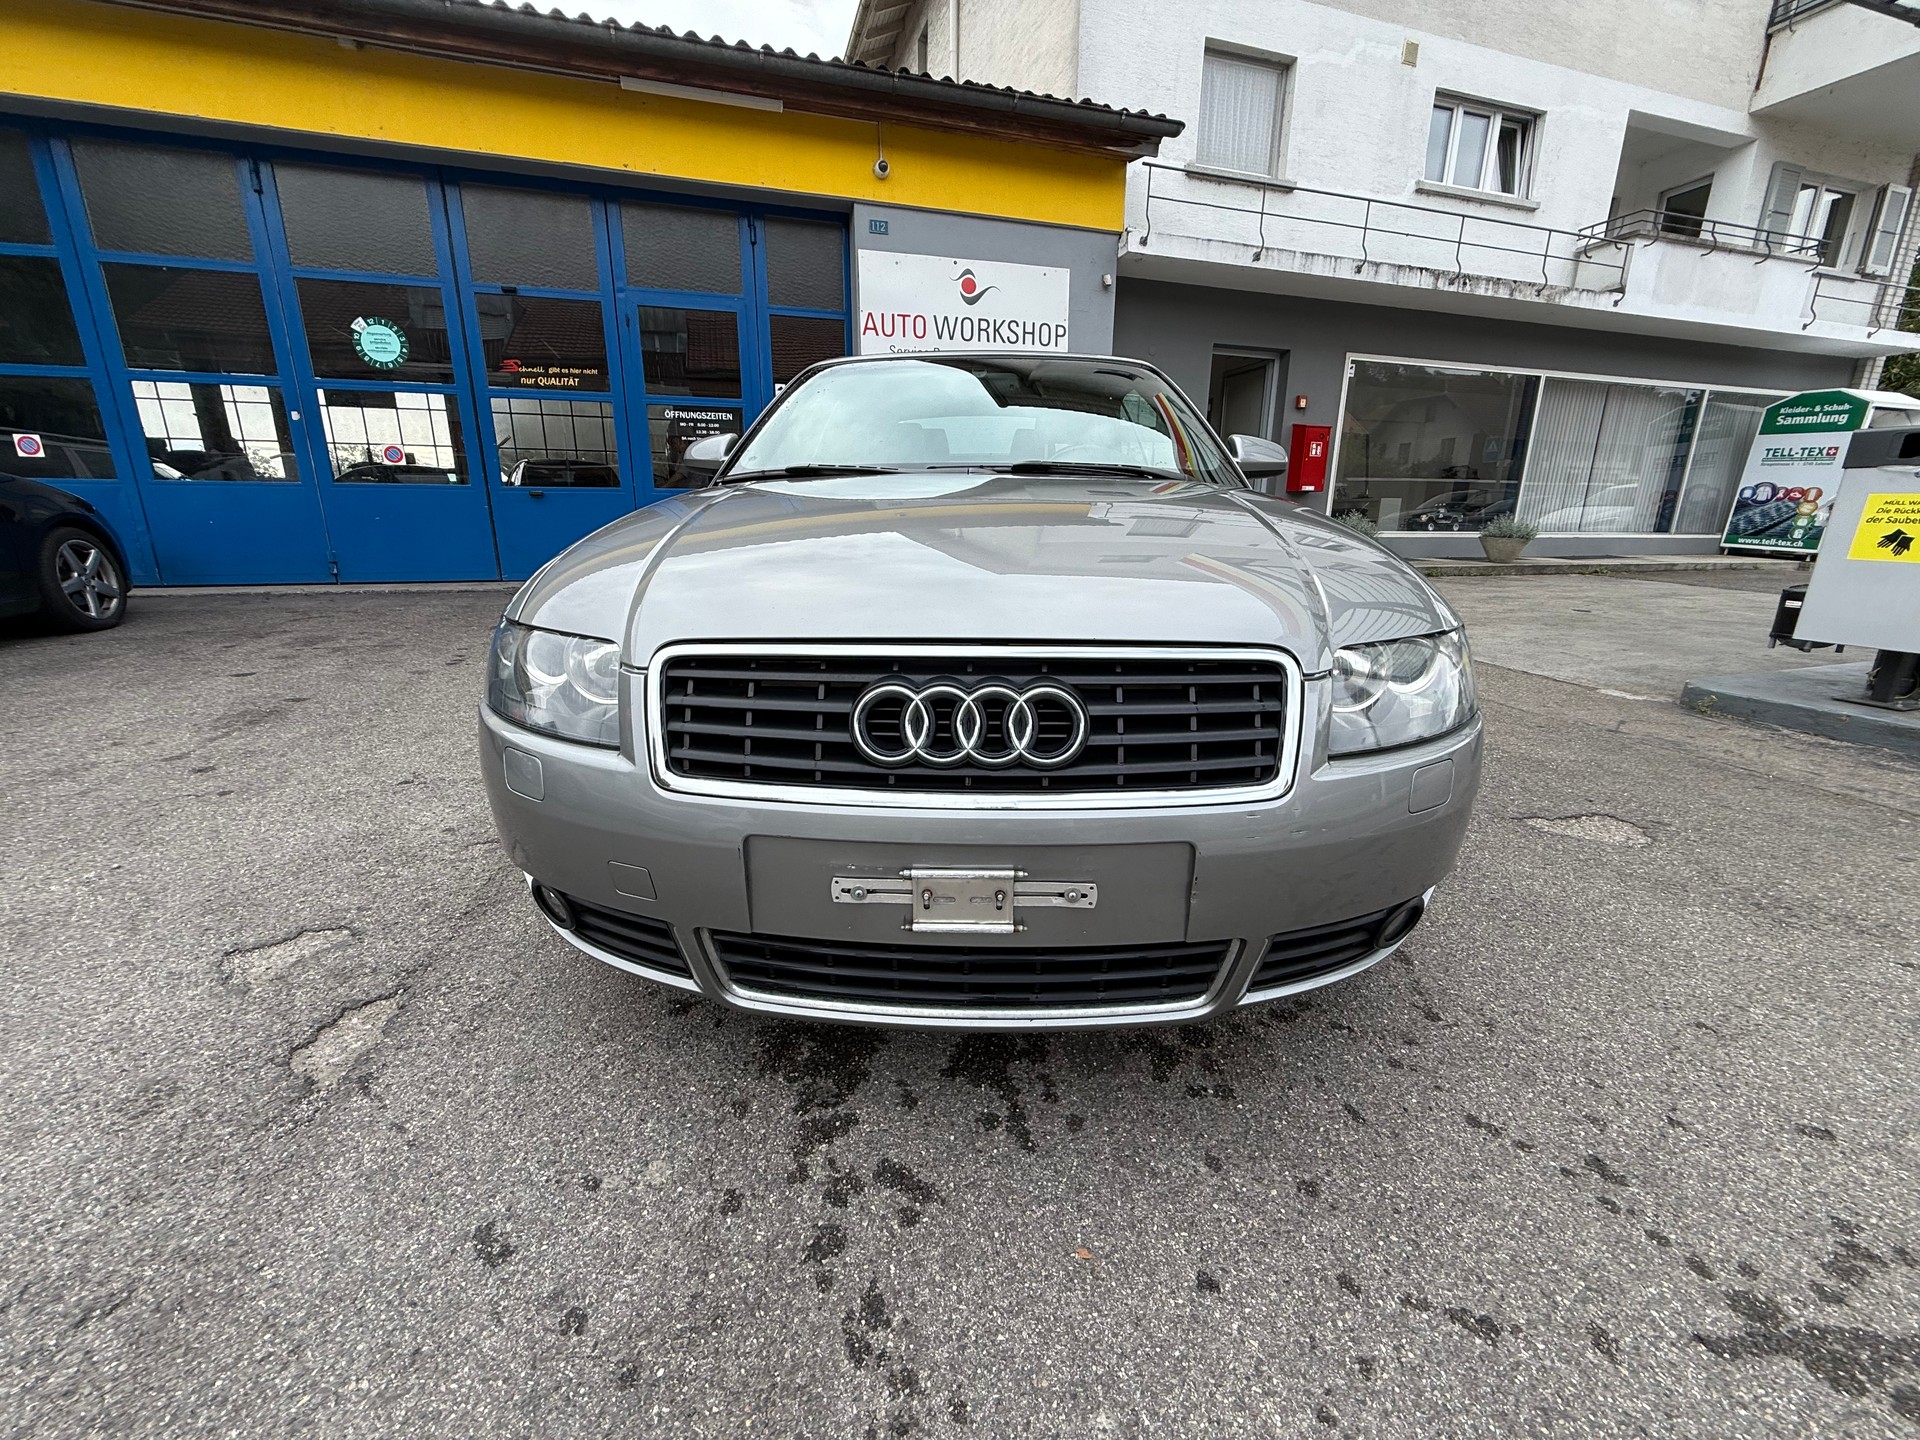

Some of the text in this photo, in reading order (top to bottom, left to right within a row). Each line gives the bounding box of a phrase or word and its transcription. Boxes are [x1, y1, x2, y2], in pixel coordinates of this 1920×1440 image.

[871, 221, 886, 232] 112
[862, 312, 1067, 348] AUTO WORKSHOP
[500, 359, 544, 373] Schnell
[569, 367, 582, 375] hier
[520, 376, 580, 386] nur QUALITÄT
[1823, 402, 1853, 412] Schuh-
[664, 409, 732, 420] ÖFFNUNGSZEITEN
[1776, 413, 1849, 425] Sammlung
[1765, 446, 1826, 458] TELL-TEX
[1738, 538, 1804, 547] www.tell-tex.ch
